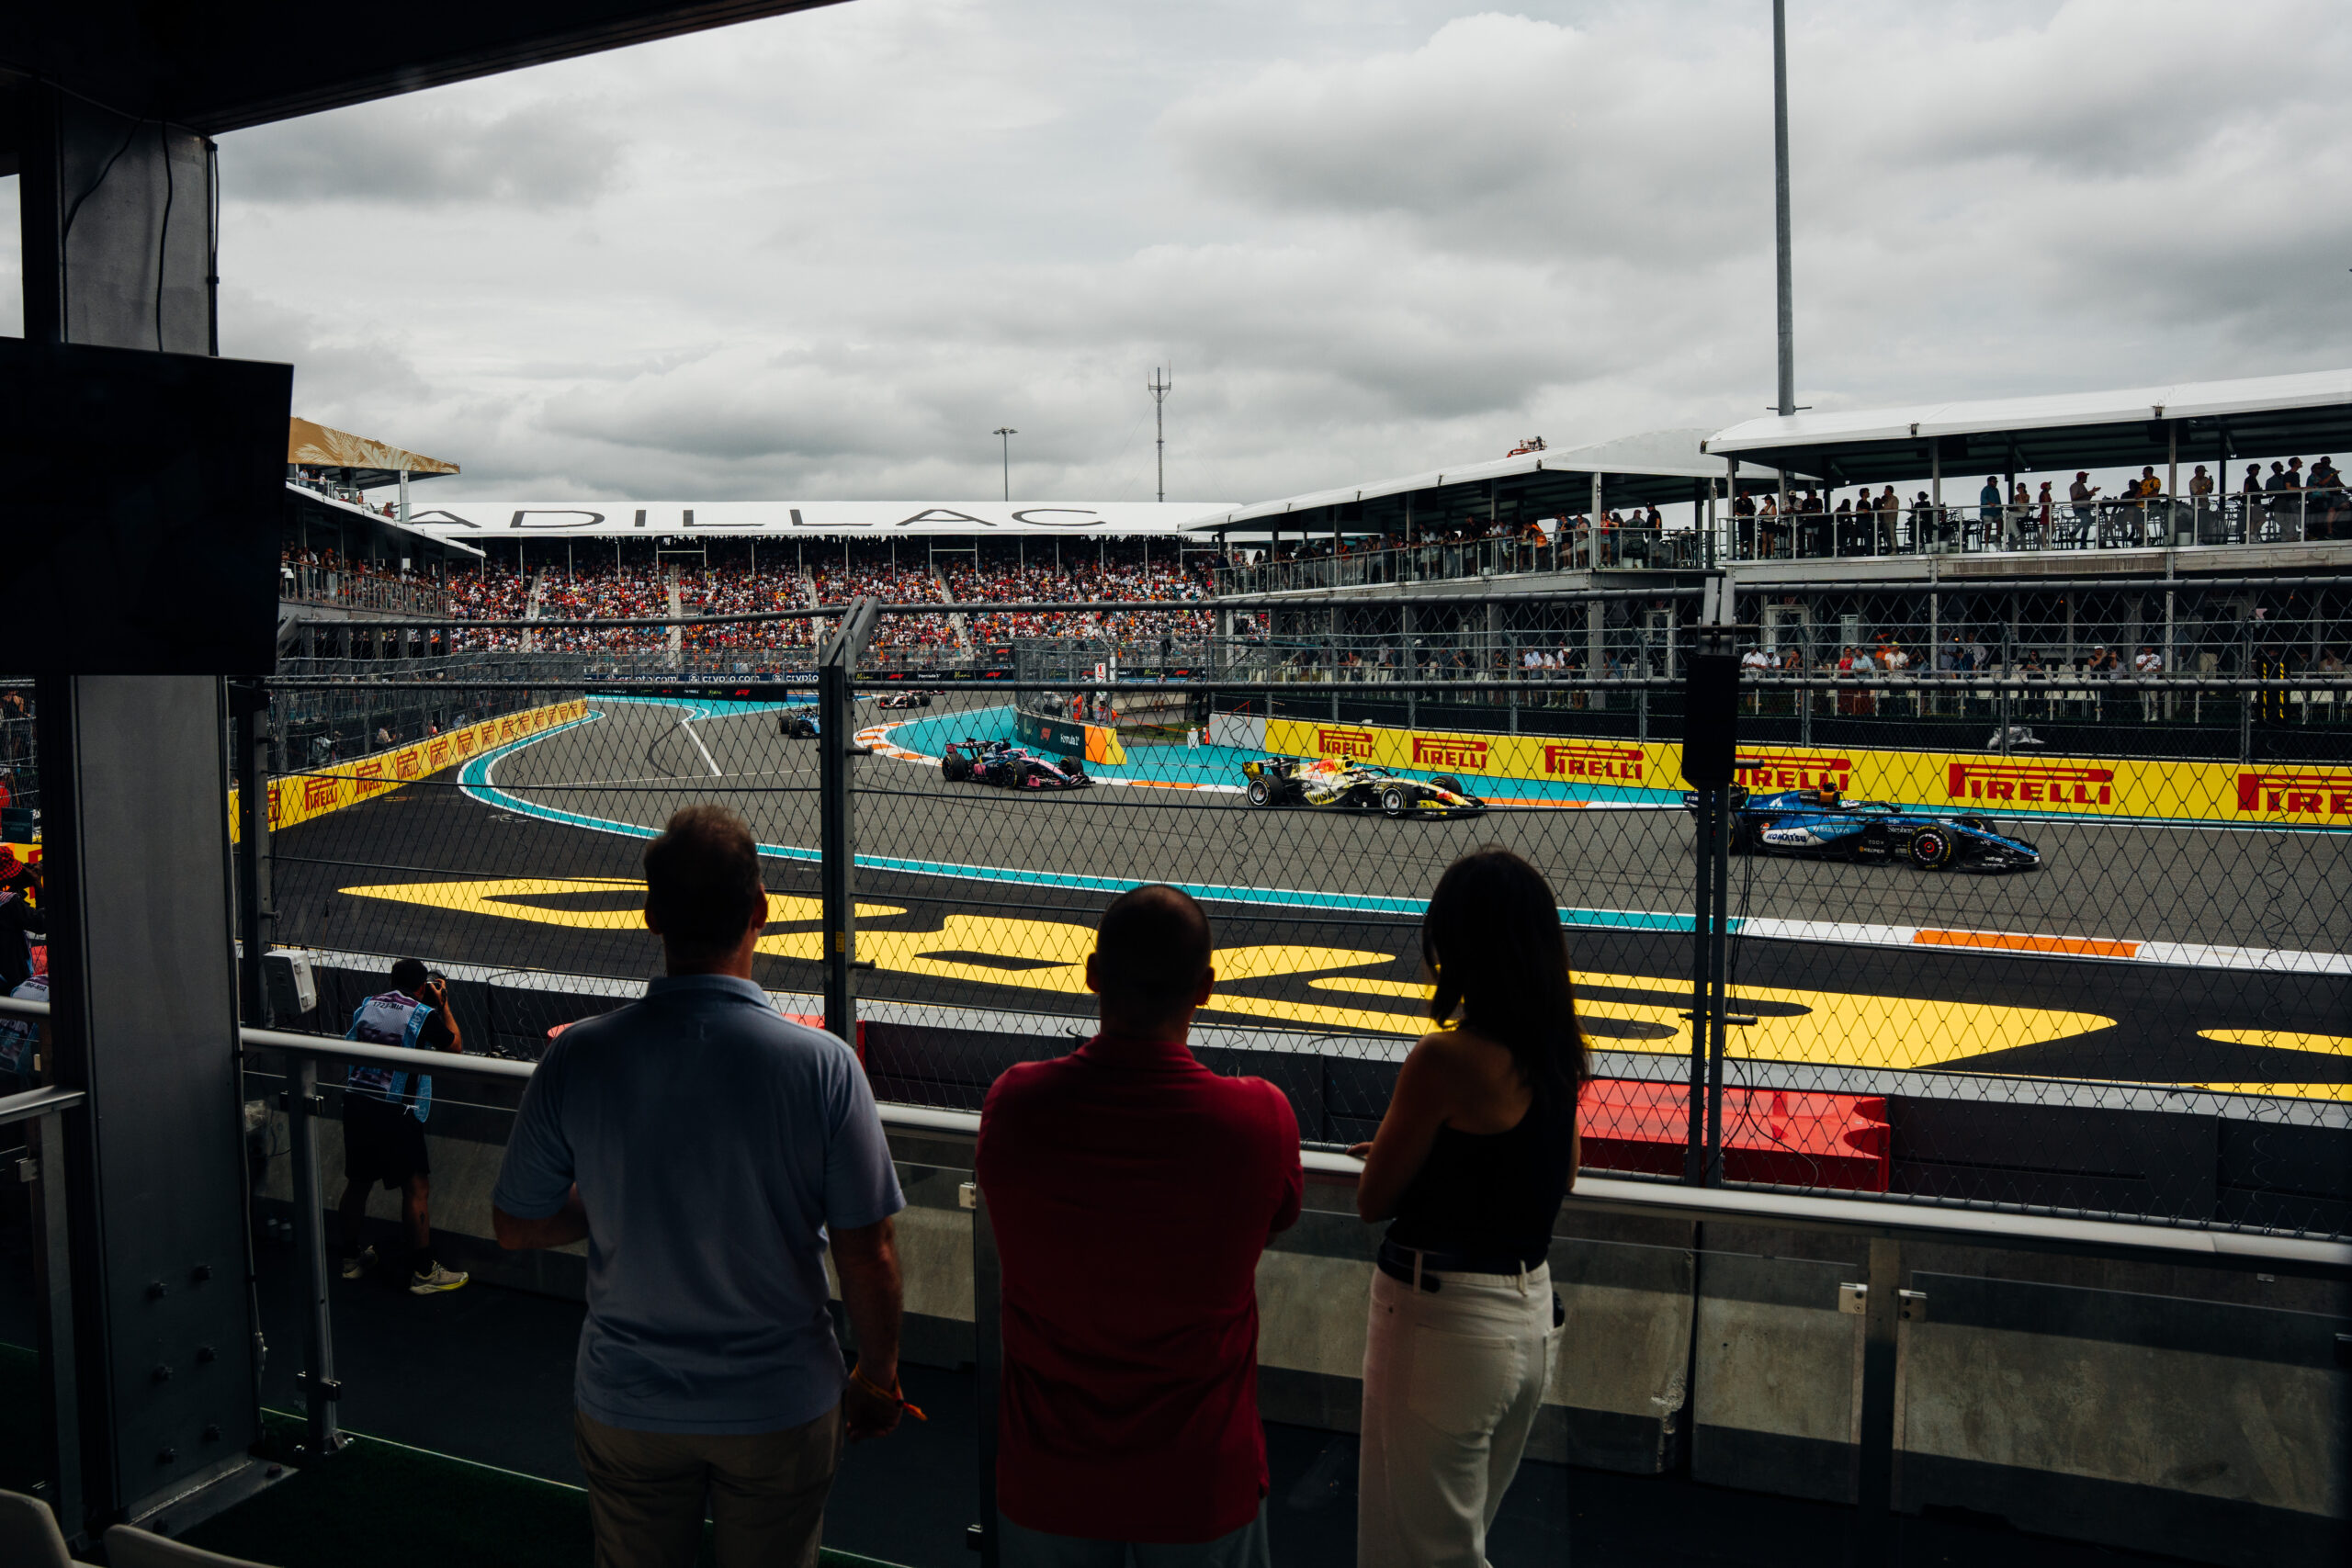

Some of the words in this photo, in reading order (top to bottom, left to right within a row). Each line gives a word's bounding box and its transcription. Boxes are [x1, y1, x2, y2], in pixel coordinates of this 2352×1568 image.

[409, 508, 1106, 529] ADILLAC
[786, 674, 819, 682] crypto
[1318, 729, 1373, 758] PIRELLI
[1413, 738, 1487, 769] PIRELLI
[397, 751, 419, 781] PIRELLI
[1545, 745, 1645, 780] PIRELLI
[305, 777, 338, 812] PIRELLI
[1312, 791, 1336, 803] VISA
[1949, 763, 2114, 806] PIRELLI
[2238, 773, 2352, 815] PIRE
[1766, 832, 1807, 843] KOMATSU
